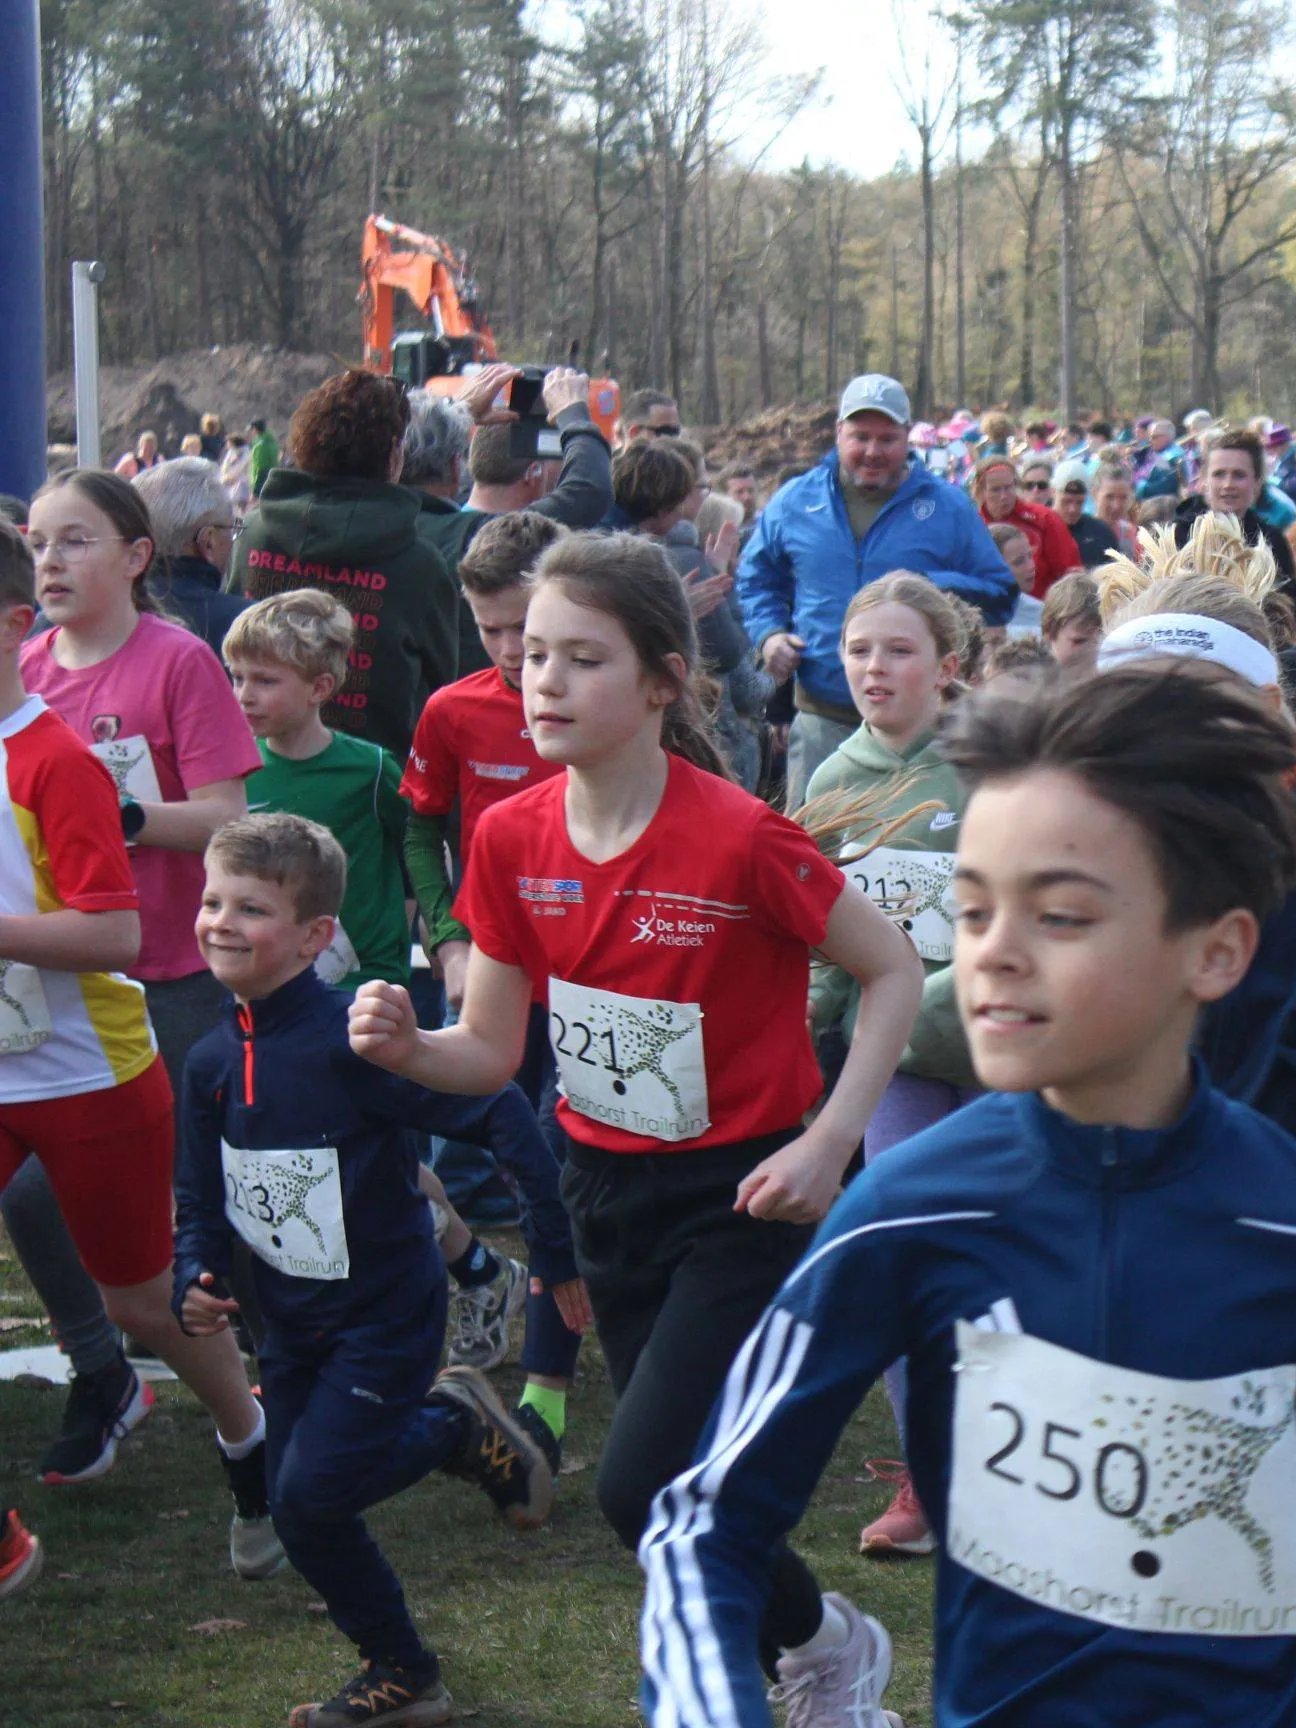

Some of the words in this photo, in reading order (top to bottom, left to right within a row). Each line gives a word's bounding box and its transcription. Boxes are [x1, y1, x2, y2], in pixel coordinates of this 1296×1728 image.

[248, 548, 388, 591] DREAMLAND
[935, 811, 956, 824] NIKE
[655, 919, 673, 933] De
[677, 920, 716, 934] Keien
[655, 933, 705, 947] Atletiek
[551, 1012, 625, 1074] 221
[631, 1110, 703, 1134] Trailrun
[286, 1255, 345, 1274] Trailrun
[984, 1401, 1148, 1519] 250
